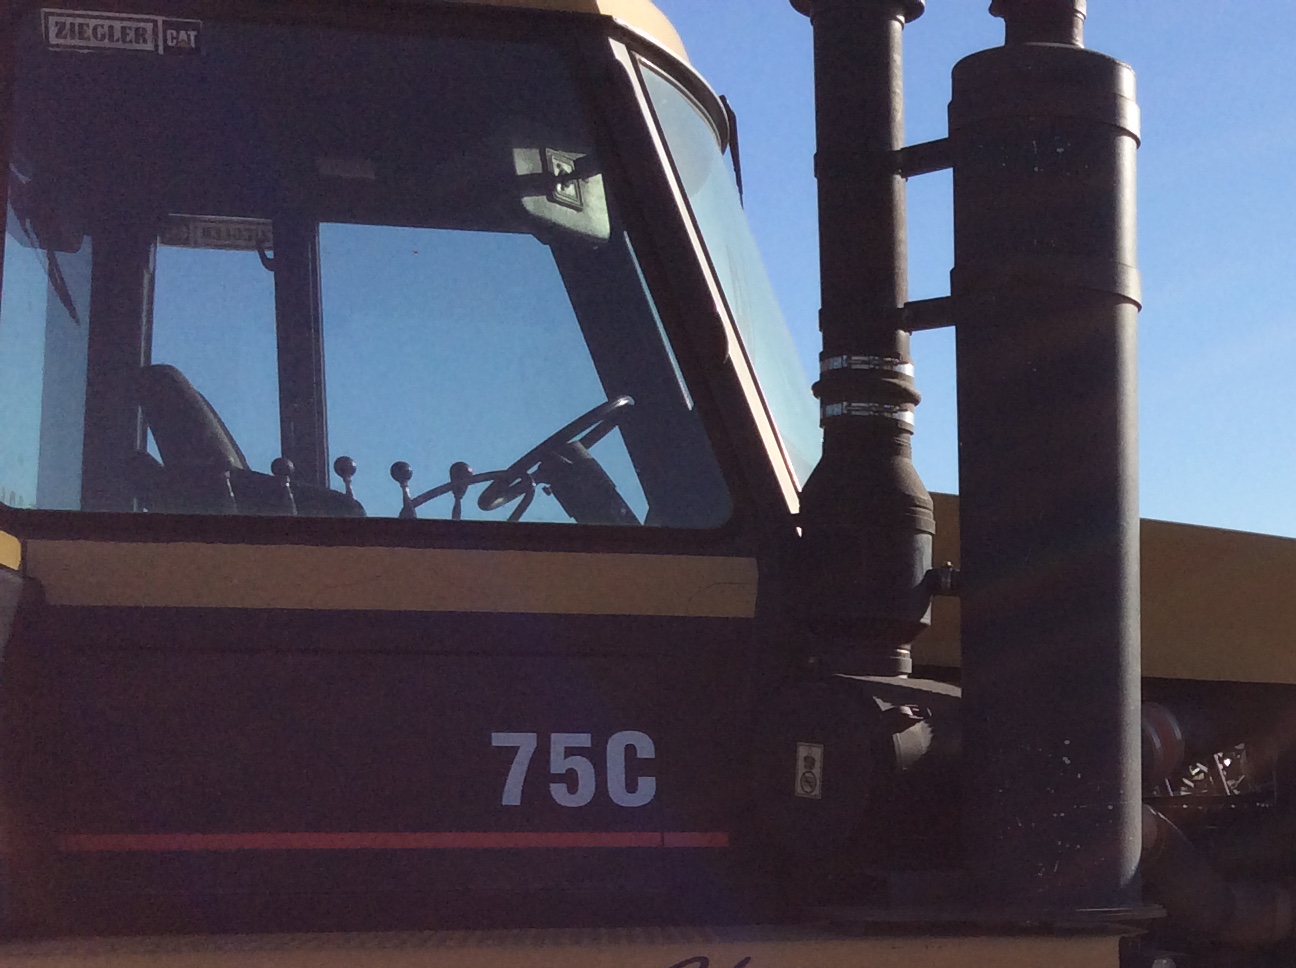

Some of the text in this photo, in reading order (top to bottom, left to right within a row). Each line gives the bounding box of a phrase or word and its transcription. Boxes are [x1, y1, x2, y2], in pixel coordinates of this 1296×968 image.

[54, 20, 198, 48] ZIEGLER CAT
[491, 730, 657, 807] 75C
